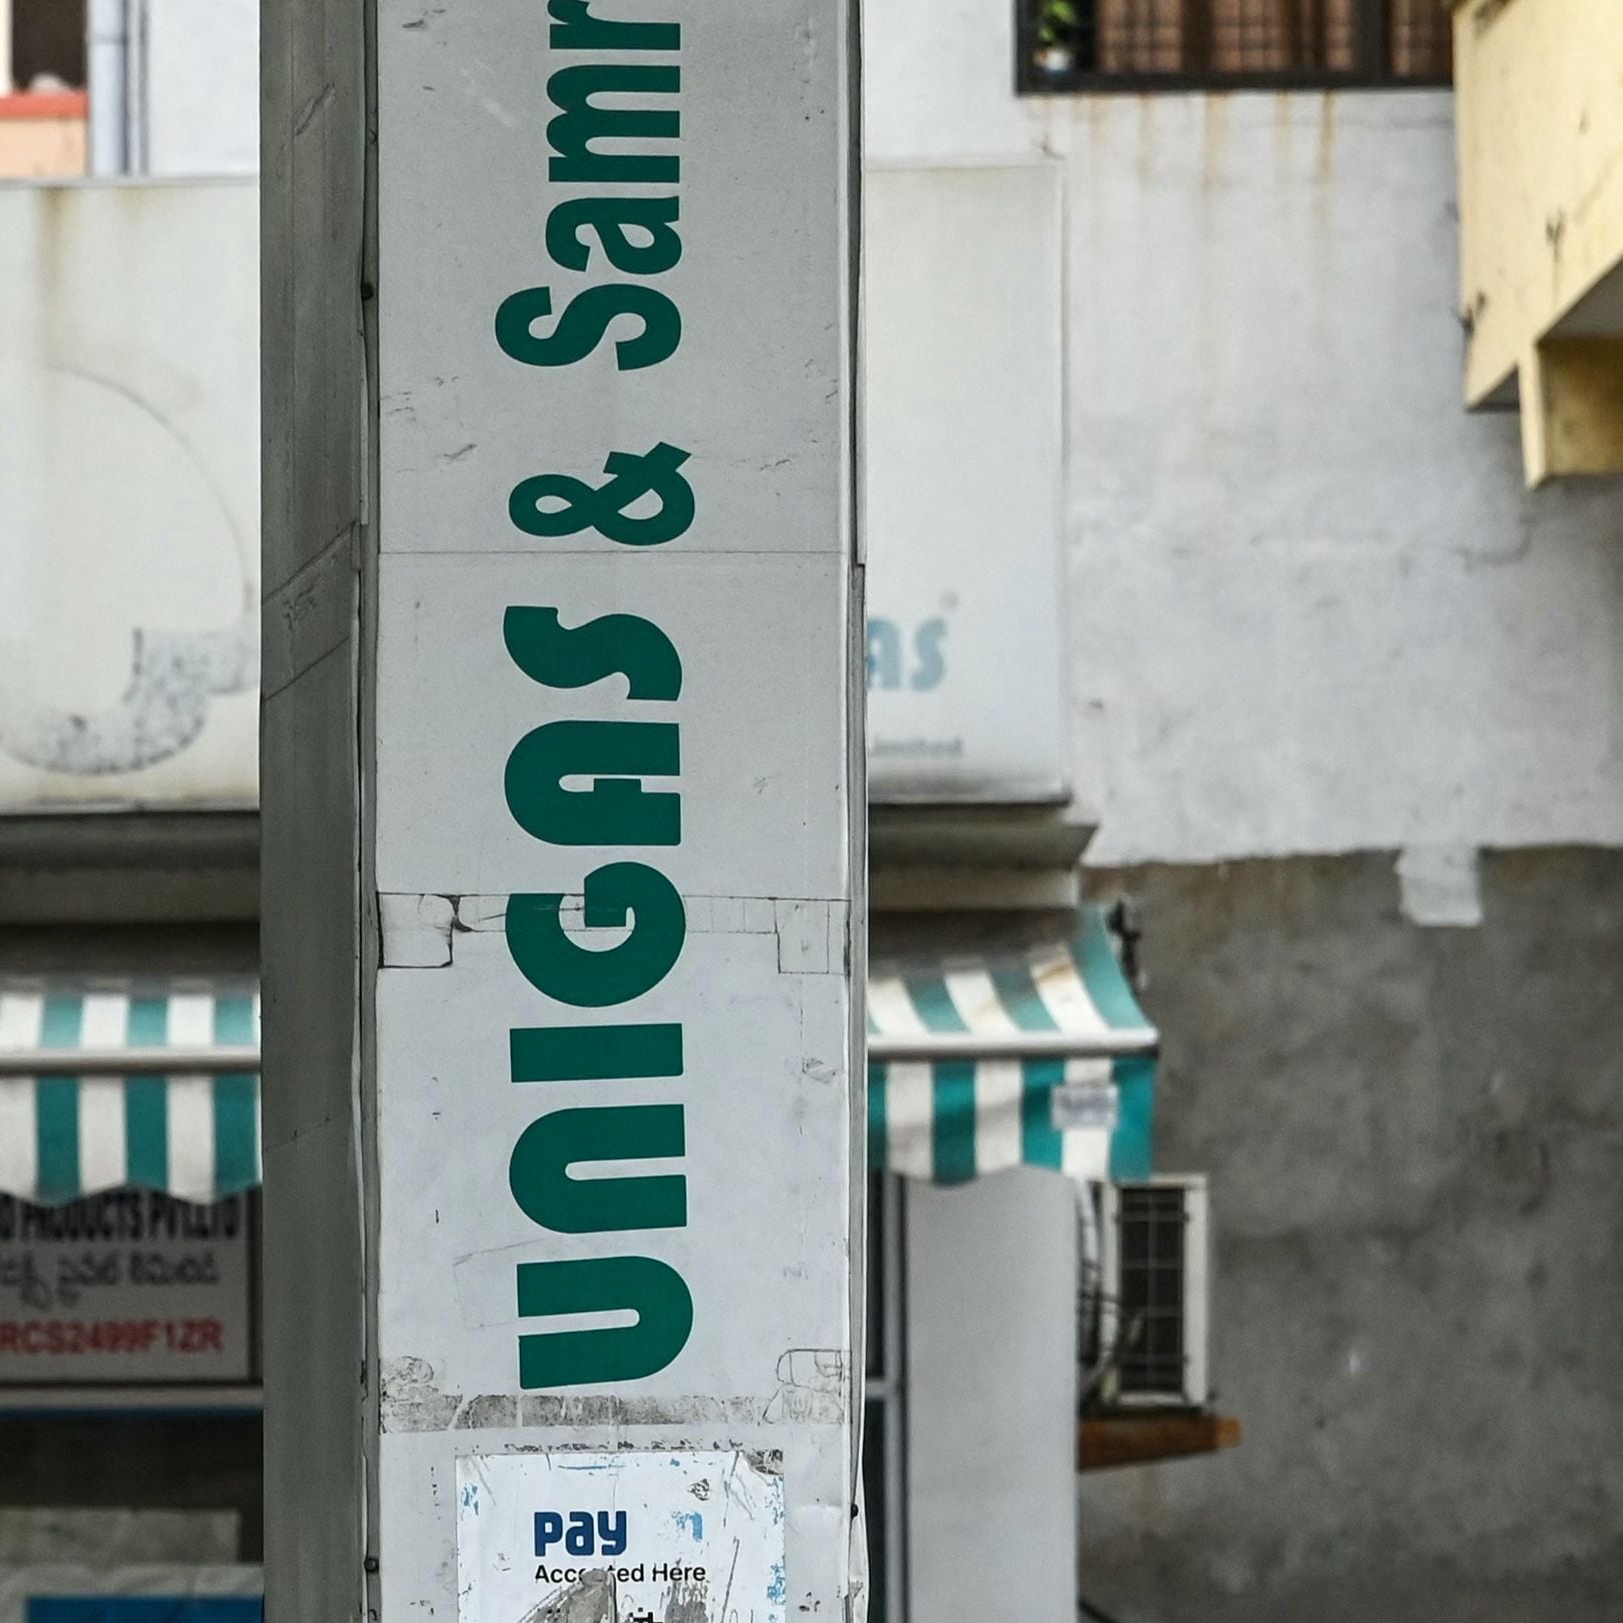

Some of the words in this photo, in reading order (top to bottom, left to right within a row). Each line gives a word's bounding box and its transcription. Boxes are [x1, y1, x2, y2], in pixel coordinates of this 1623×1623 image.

[508, 442, 696, 546] &
[503, 605, 694, 1390] UNIGAS
[652, 1562, 706, 1583] Here
